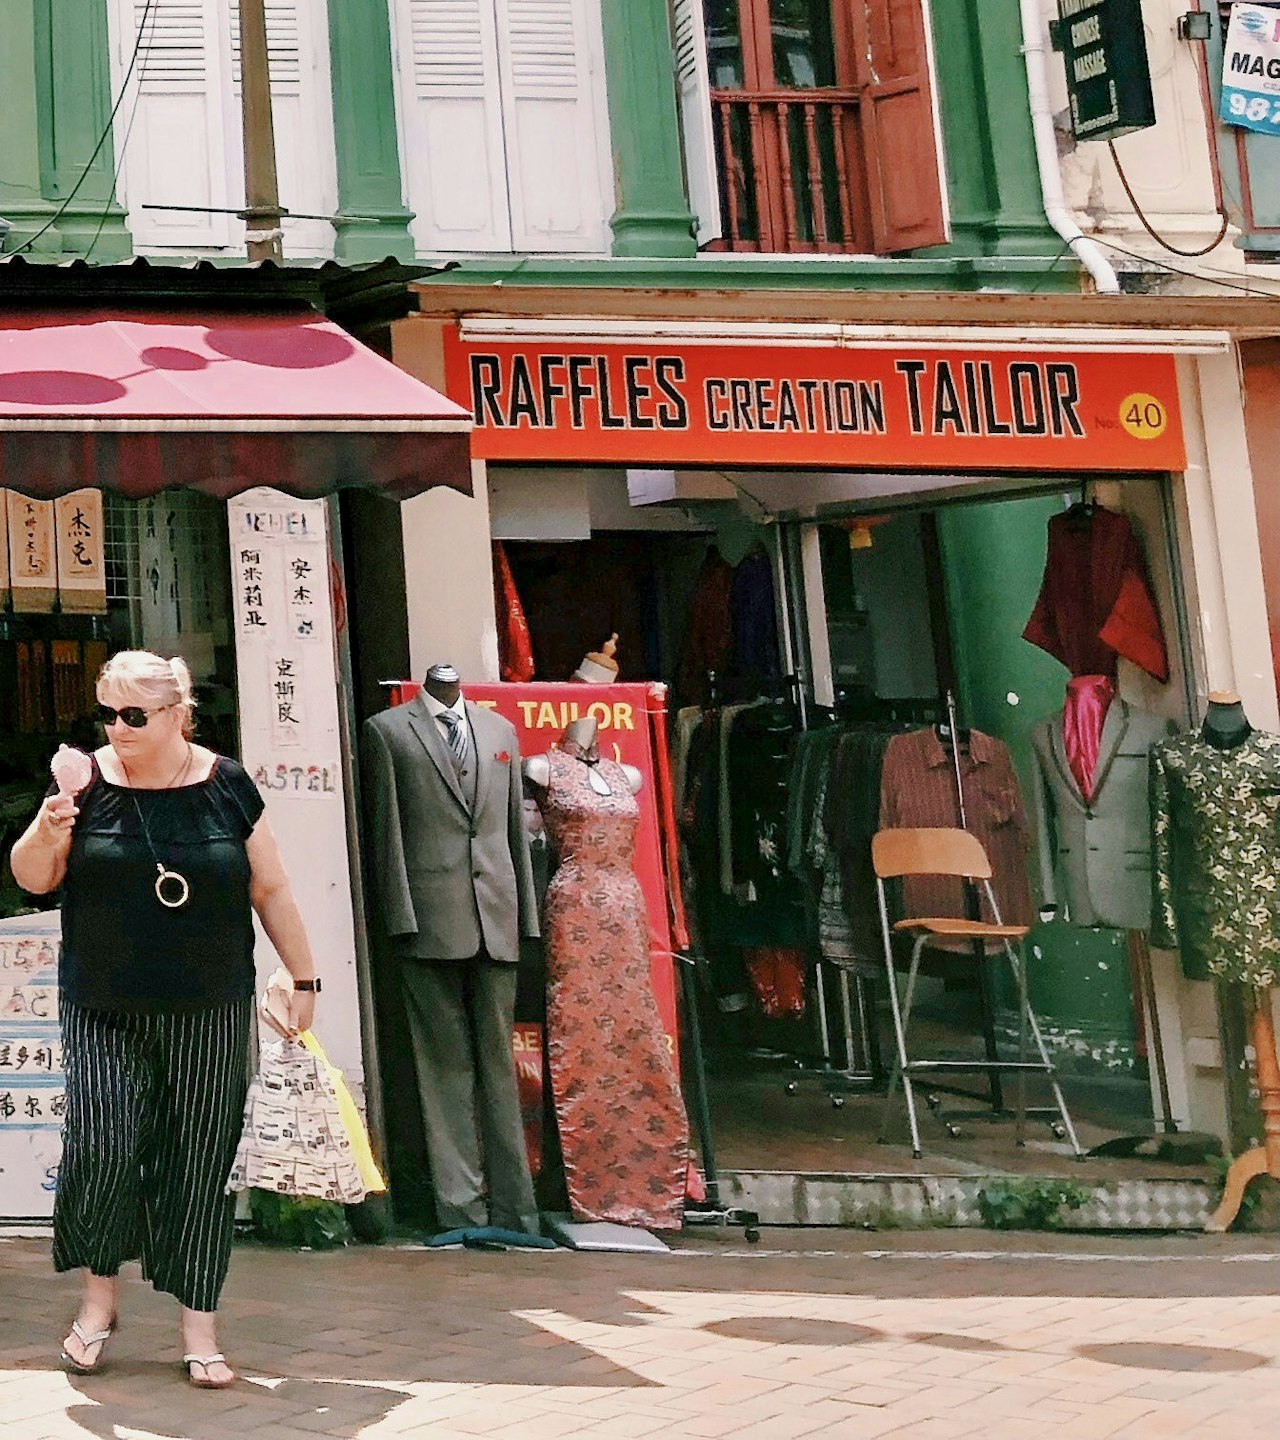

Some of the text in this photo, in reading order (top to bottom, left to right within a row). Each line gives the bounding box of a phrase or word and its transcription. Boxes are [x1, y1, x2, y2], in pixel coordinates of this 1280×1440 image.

[1230, 51, 1280, 79] MAG
[468, 353, 690, 431] RAFFLES
[702, 377, 888, 435] CREATION
[894, 359, 1087, 438] TAILOR
[1125, 402, 1163, 429] 40
